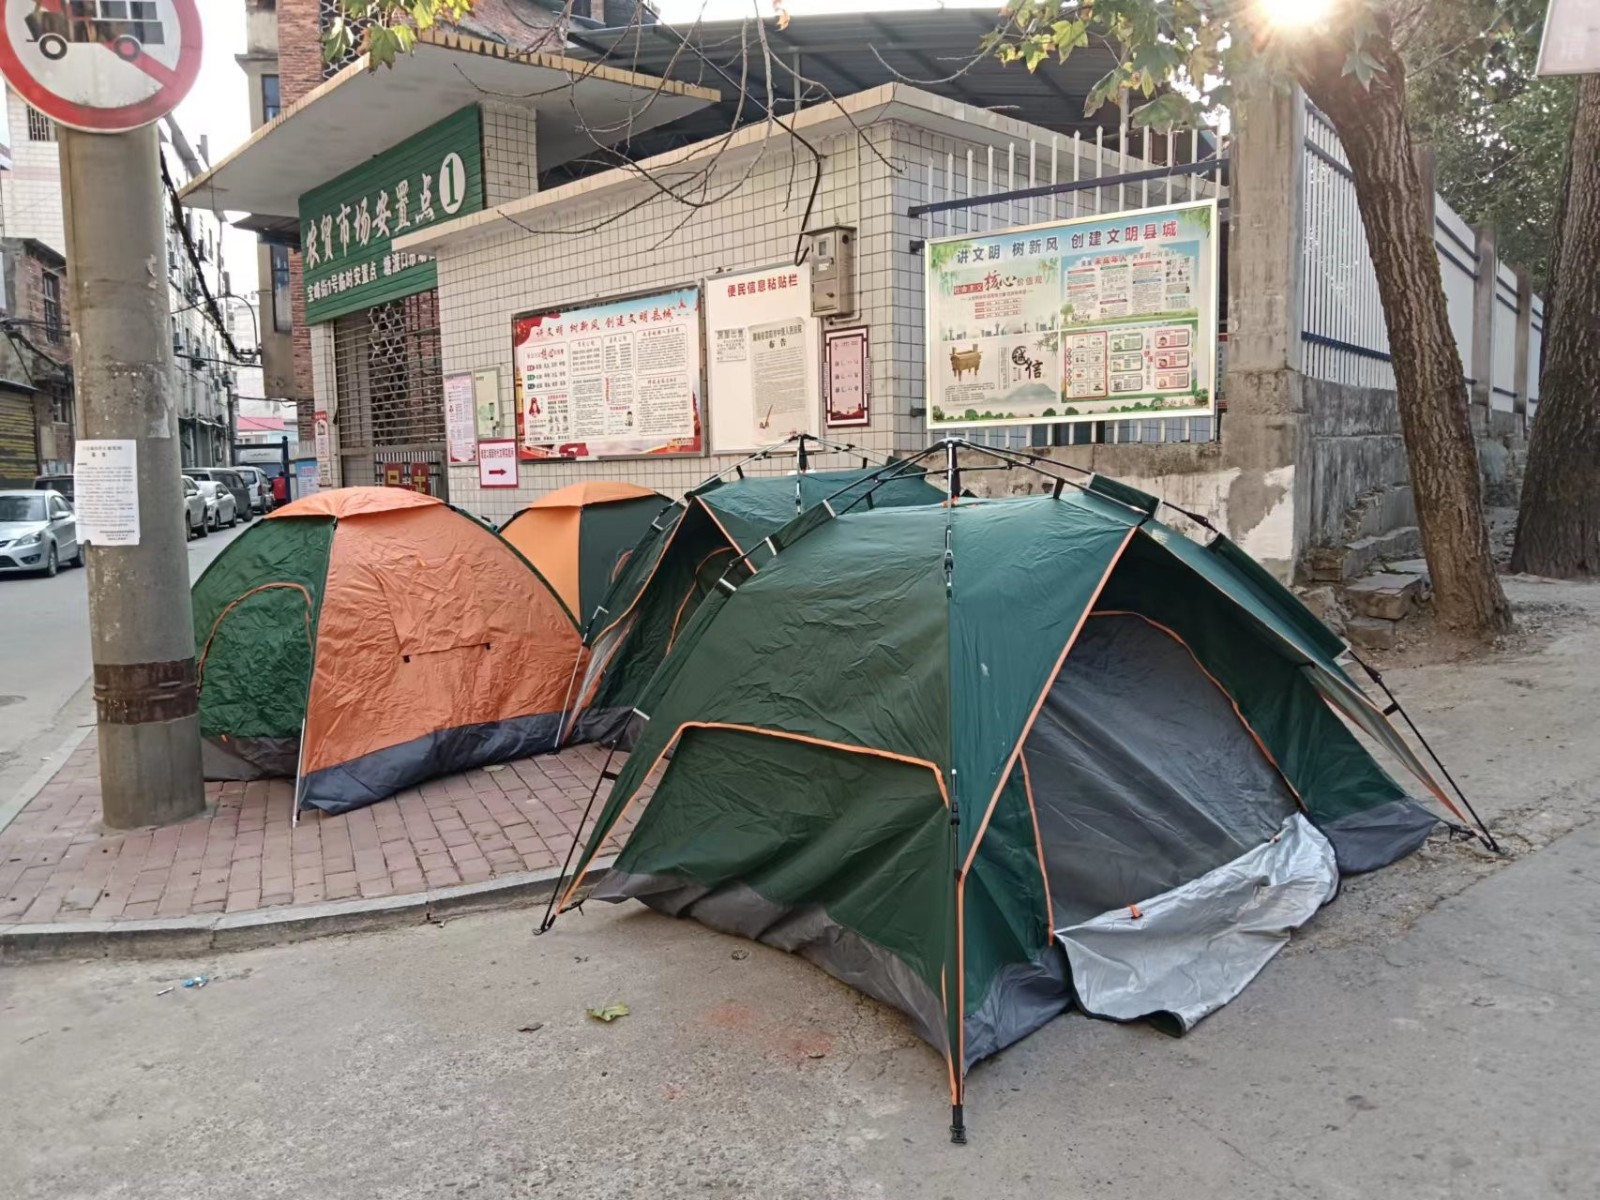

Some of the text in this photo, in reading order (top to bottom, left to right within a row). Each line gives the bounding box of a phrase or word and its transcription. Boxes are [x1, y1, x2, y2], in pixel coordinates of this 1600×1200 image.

[306, 173, 435, 269] 农贸市场安置点
[957, 220, 1178, 264] 讲文明 树新风 创建文明县城
[727, 274, 799, 297] 便民信息粘贴栏
[536, 308, 674, 338] 讲文明 树新风 创建文明县城
